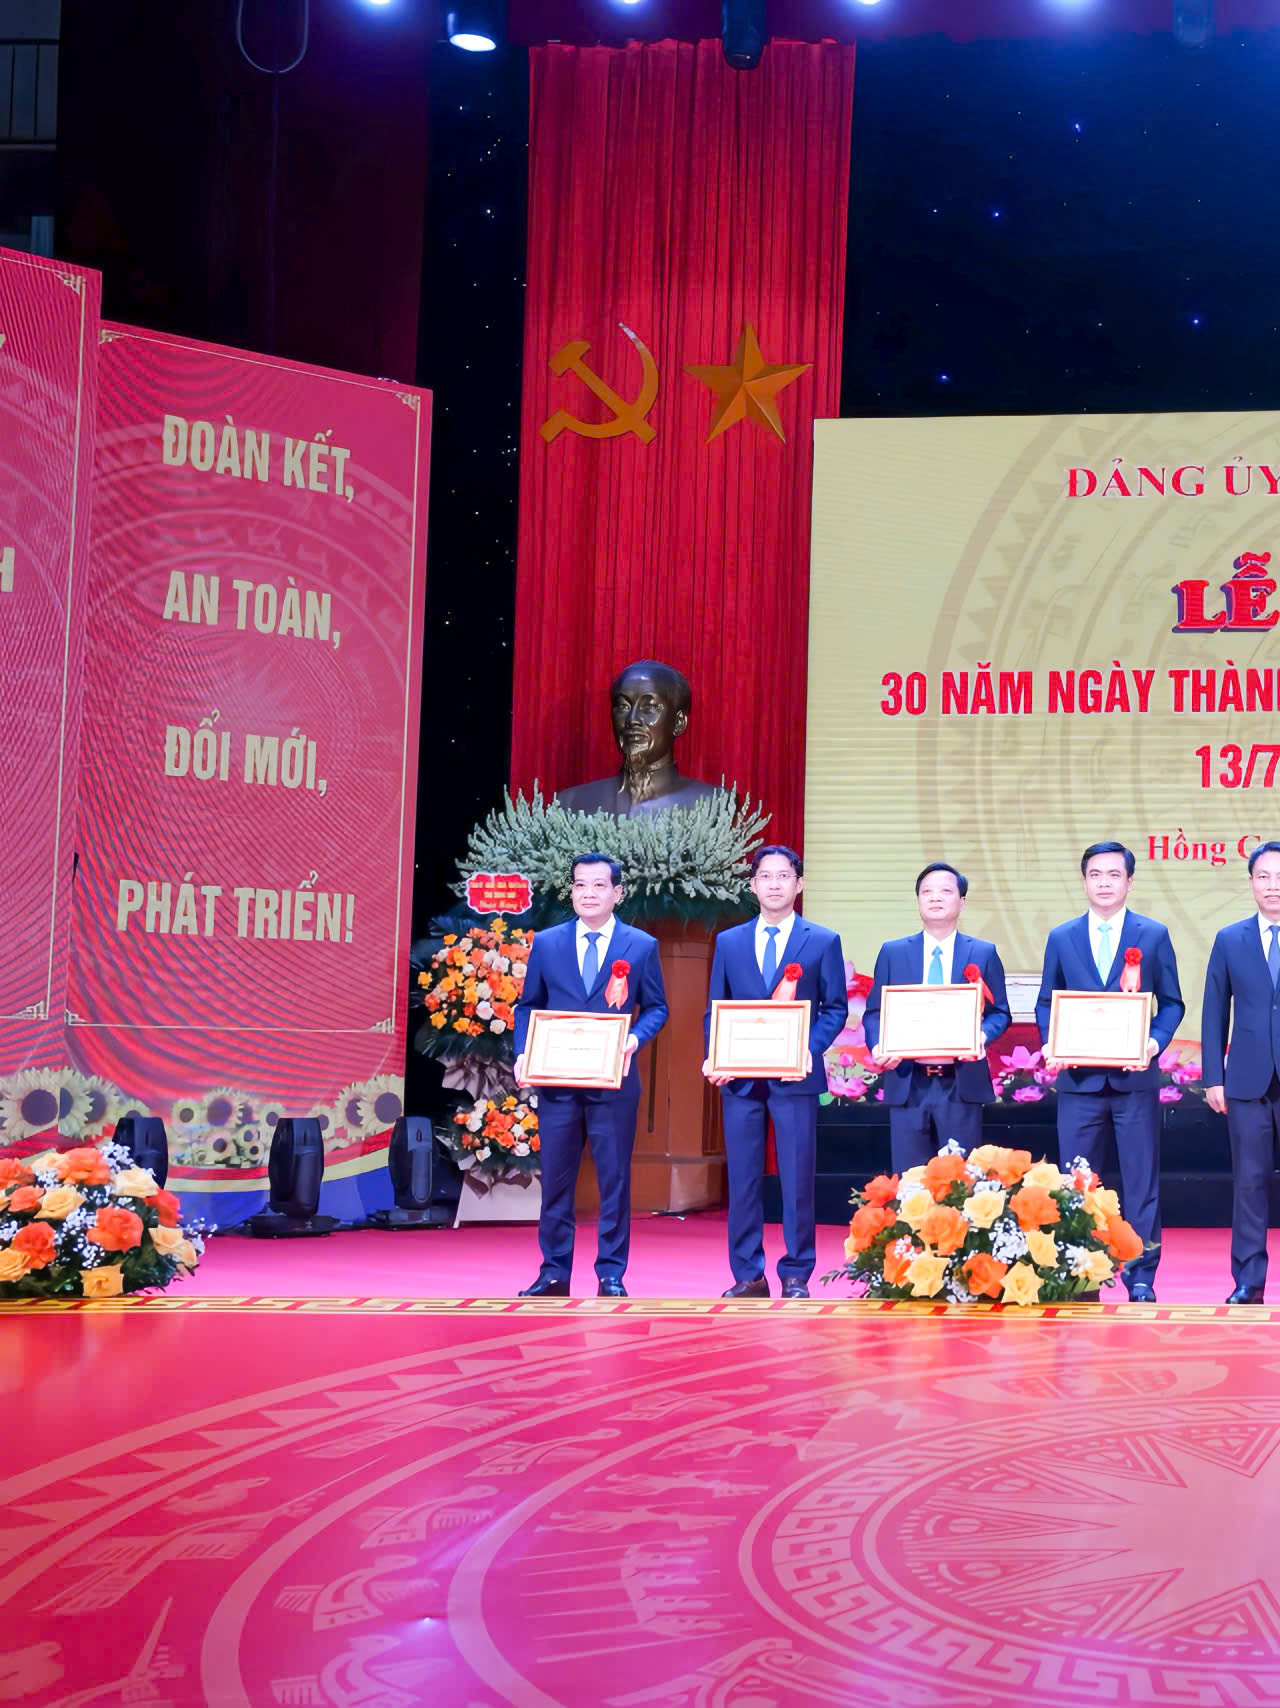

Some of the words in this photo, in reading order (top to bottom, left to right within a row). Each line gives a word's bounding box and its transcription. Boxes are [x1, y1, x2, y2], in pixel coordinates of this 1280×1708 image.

[162, 415, 271, 483] ĐOÀN
[284, 430, 355, 504] KẾT,
[1067, 459, 1206, 499] ĐẢNG
[162, 570, 220, 626] AN
[233, 576, 343, 650] TOÀN,
[880, 671, 929, 717] 30
[942, 662, 1035, 716] NĂM
[1047, 660, 1157, 716] NGÀY
[163, 708, 232, 783] ĐỔI
[243, 727, 330, 798] MỚI,
[1147, 827, 1228, 867] Hồng
[116, 871, 223, 938] PHÁT
[233, 869, 356, 945] TRIỂN!
